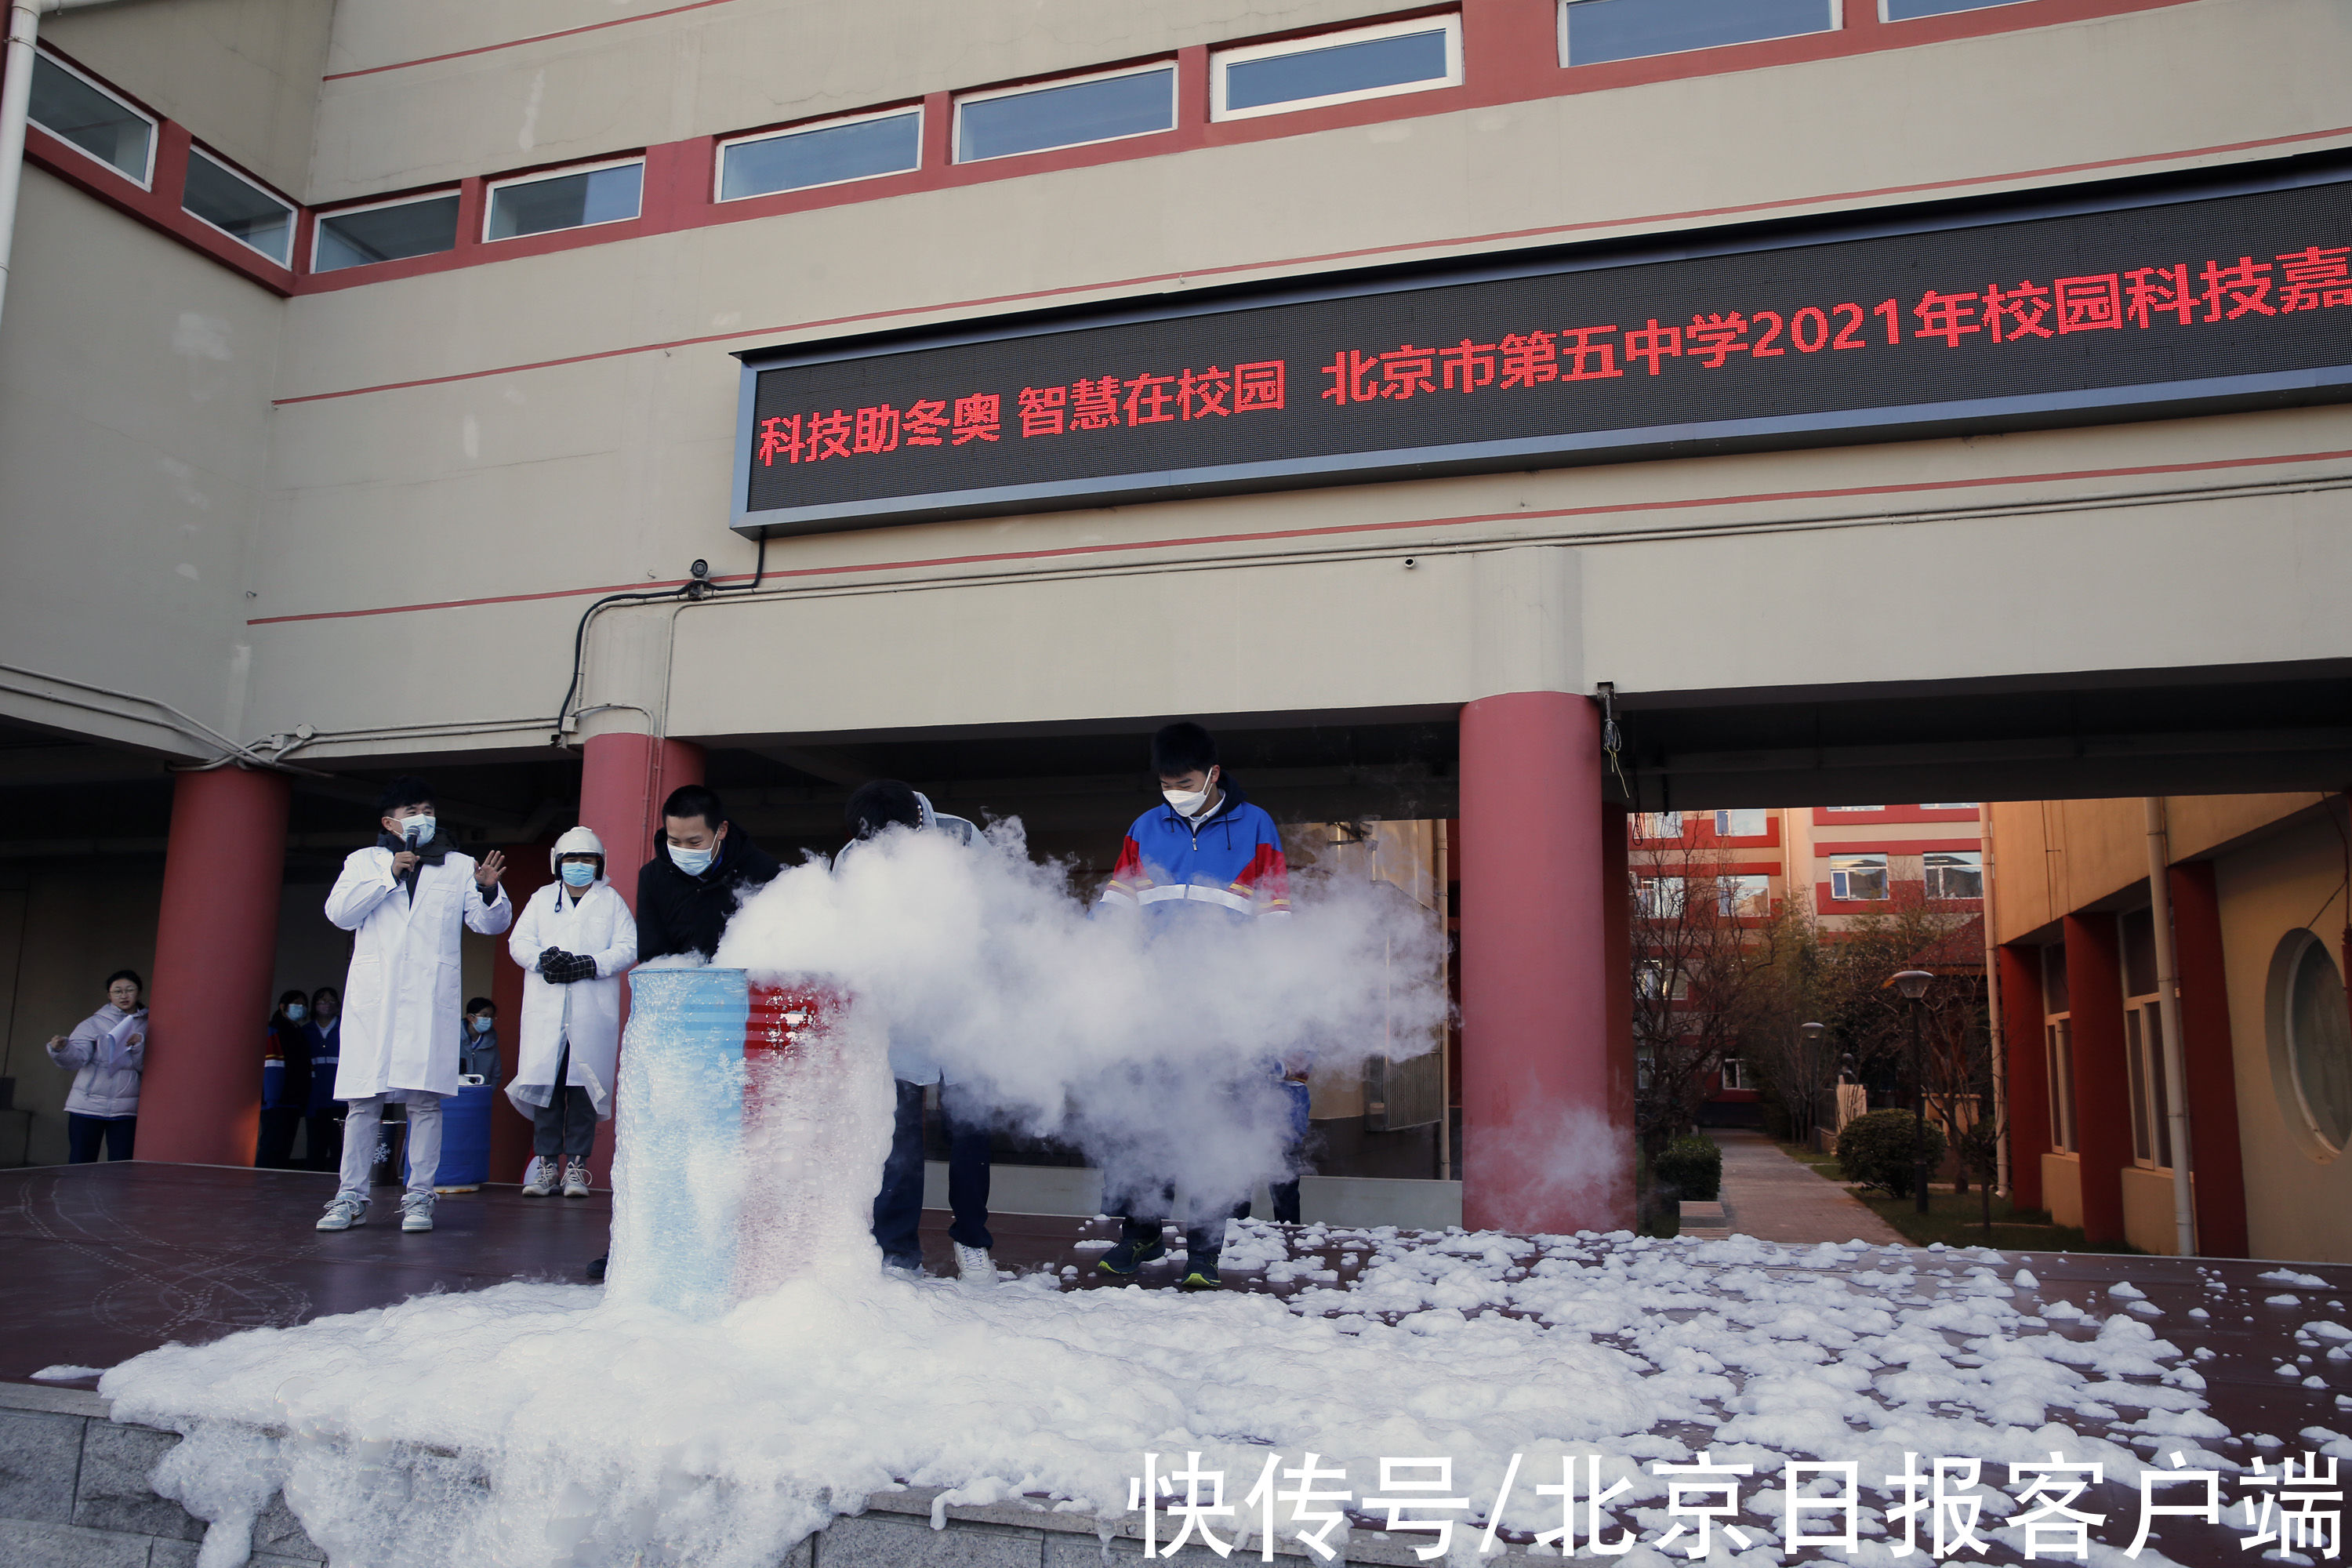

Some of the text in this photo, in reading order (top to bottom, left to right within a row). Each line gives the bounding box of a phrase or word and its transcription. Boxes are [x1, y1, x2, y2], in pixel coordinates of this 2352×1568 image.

[758, 245, 2352, 466] 科技助冬奥 智慧在校园 北京市第五中学2021年校园科技嘉
